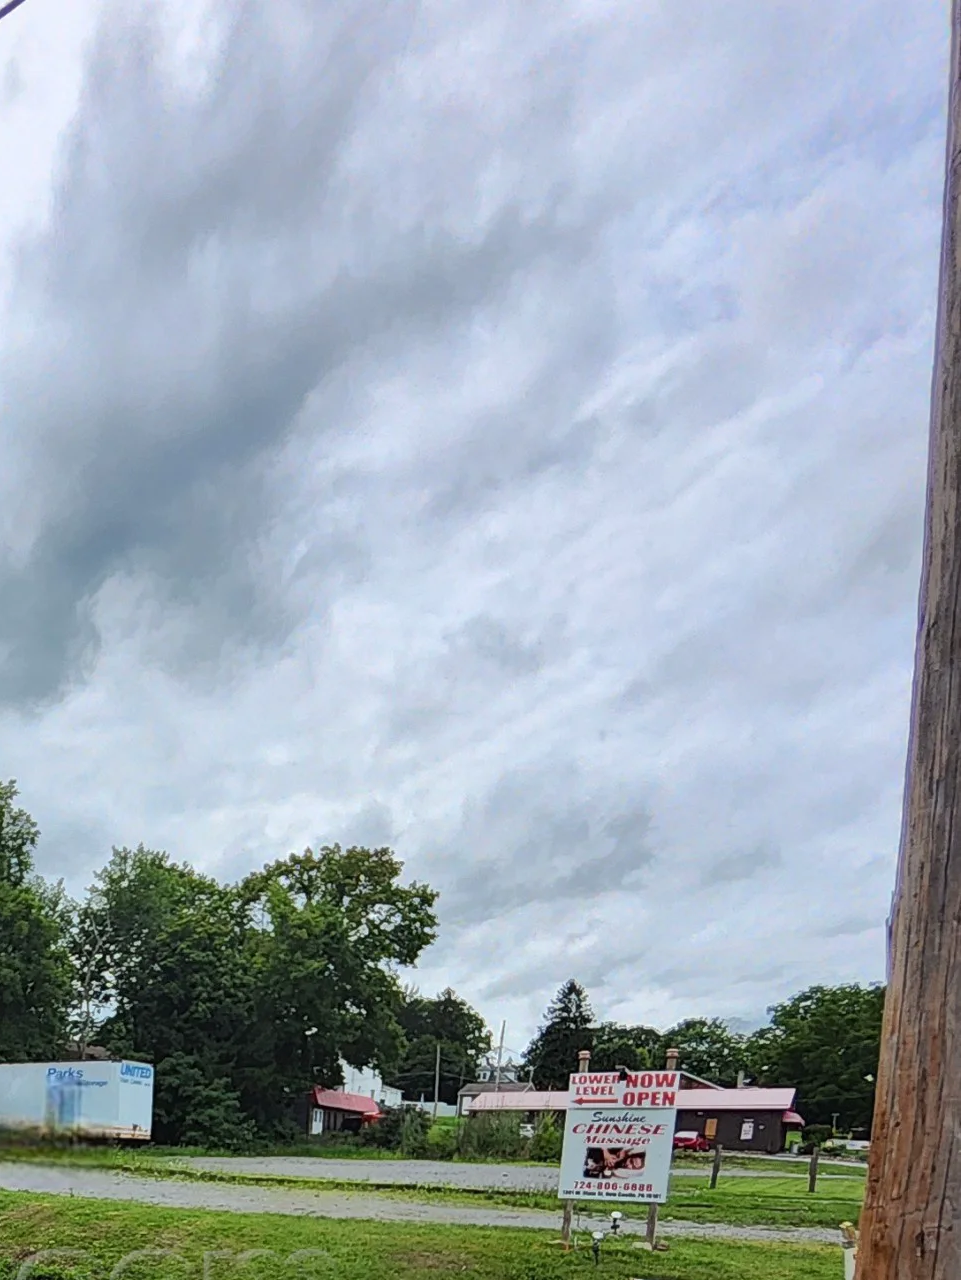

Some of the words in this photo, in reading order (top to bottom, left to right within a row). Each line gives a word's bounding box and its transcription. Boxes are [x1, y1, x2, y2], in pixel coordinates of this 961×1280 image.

[47, 1067, 84, 1079] Parks
[120, 1064, 152, 1079] UNITED
[571, 1075, 620, 1085] LOWER
[626, 1073, 677, 1089] NOW
[575, 1086, 615, 1095] LEVEL
[622, 1091, 676, 1106] OPEN
[591, 1111, 647, 1122] Sunshine
[572, 1123, 668, 1135] CHINESE
[584, 1135, 651, 1146] Massage
